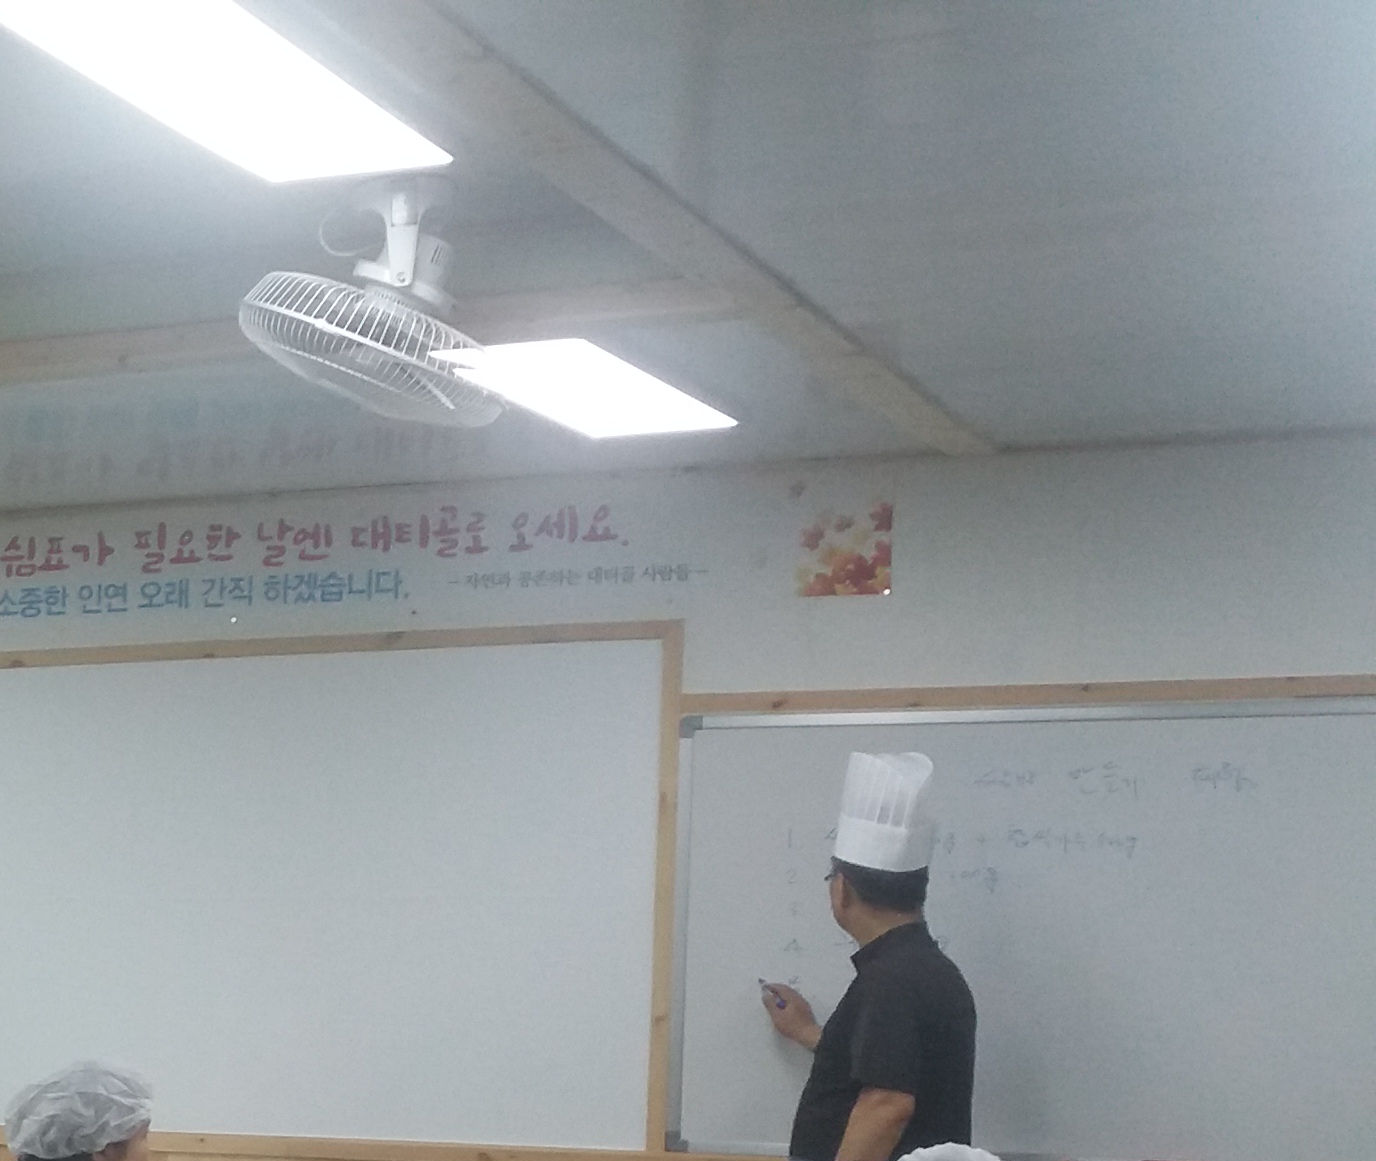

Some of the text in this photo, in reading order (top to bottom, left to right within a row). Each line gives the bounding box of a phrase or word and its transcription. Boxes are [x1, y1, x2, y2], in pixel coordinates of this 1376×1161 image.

[0, 530, 115, 578] 쉼표가
[134, 522, 242, 574] 필요한
[257, 518, 333, 567] 날엔
[351, 504, 489, 558] 대티골로
[508, 504, 629, 552] 오세요.
[77, 581, 128, 614] 인연
[137, 577, 190, 610] 오래
[201, 575, 253, 608] 간직
[263, 568, 410, 604] 하겠습니다.
[587, 565, 635, 584] 대티골
[643, 562, 689, 582] 사람들
